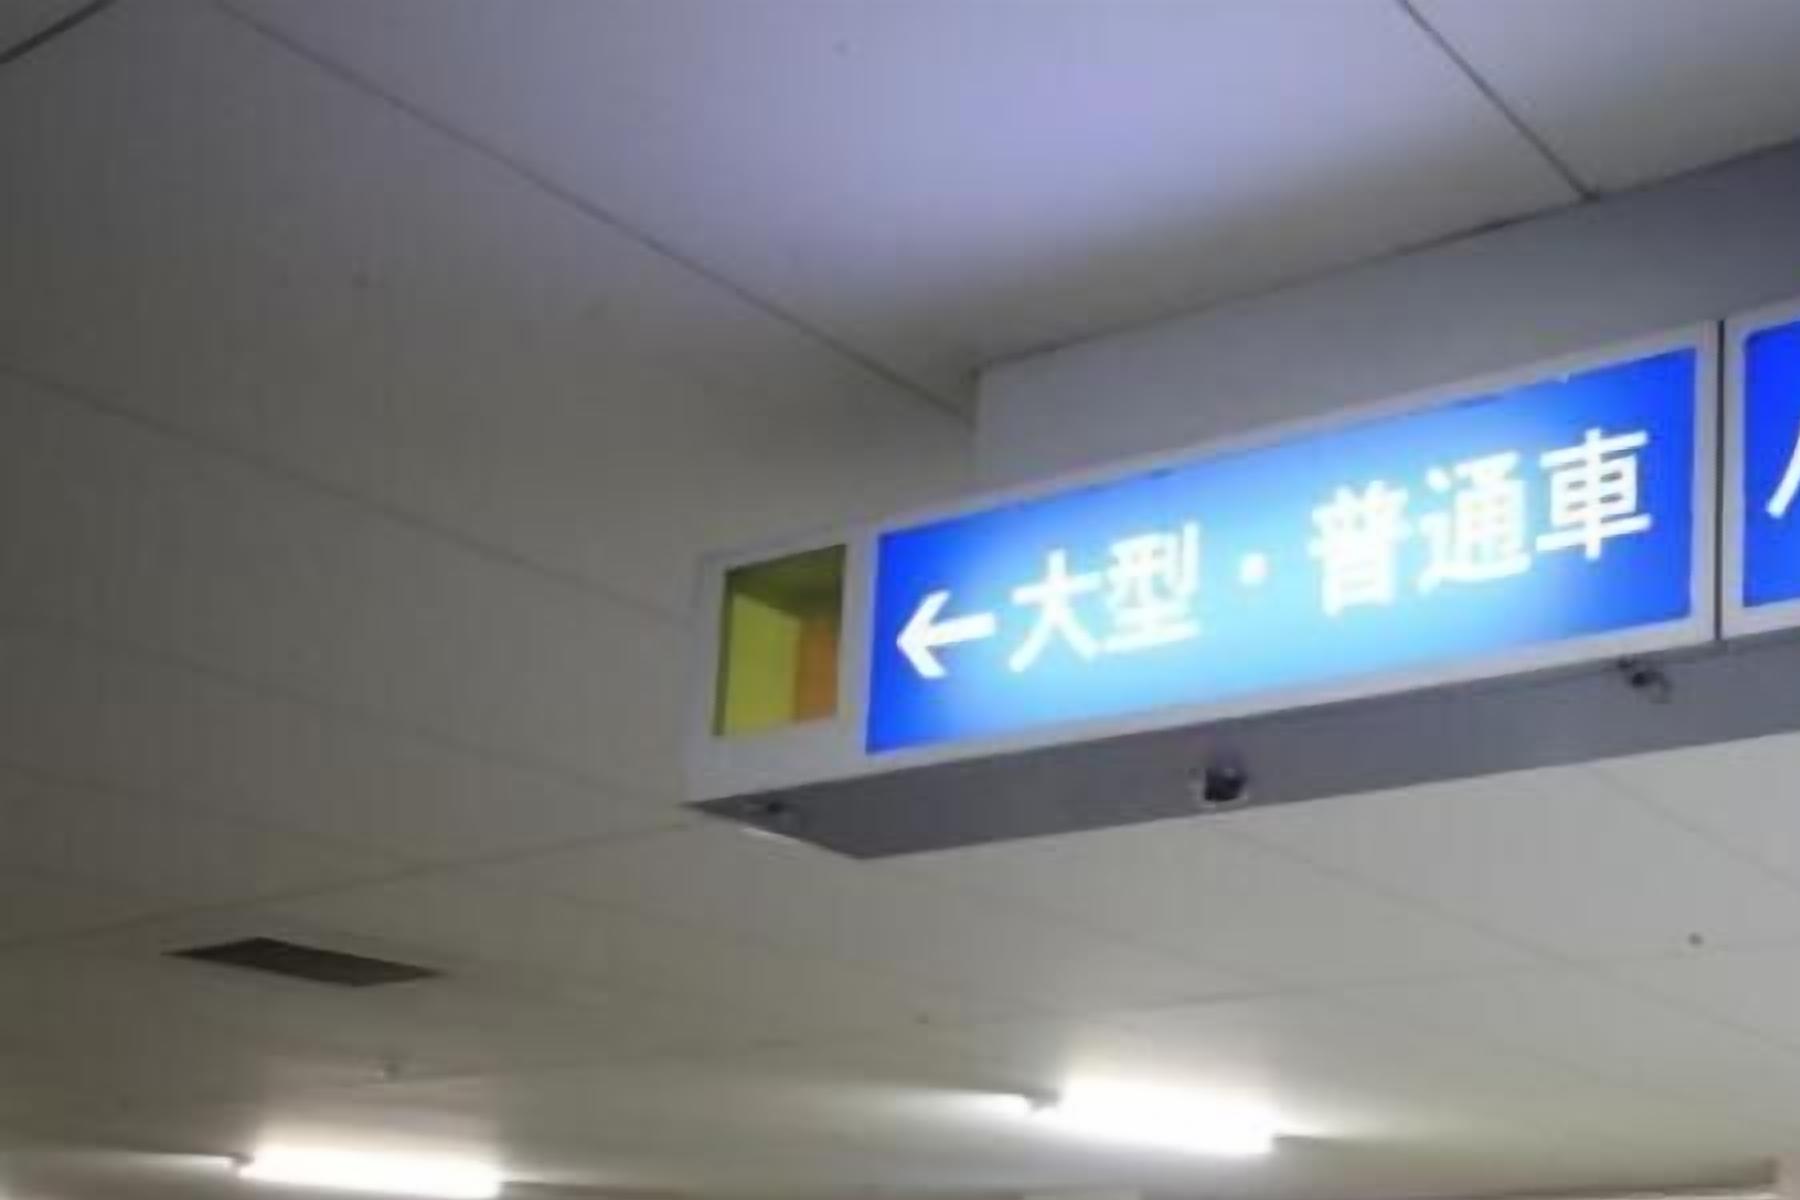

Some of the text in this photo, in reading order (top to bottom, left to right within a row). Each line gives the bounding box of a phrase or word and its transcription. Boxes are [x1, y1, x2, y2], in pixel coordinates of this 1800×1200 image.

[1008, 428, 1652, 672] 大型・普通車
